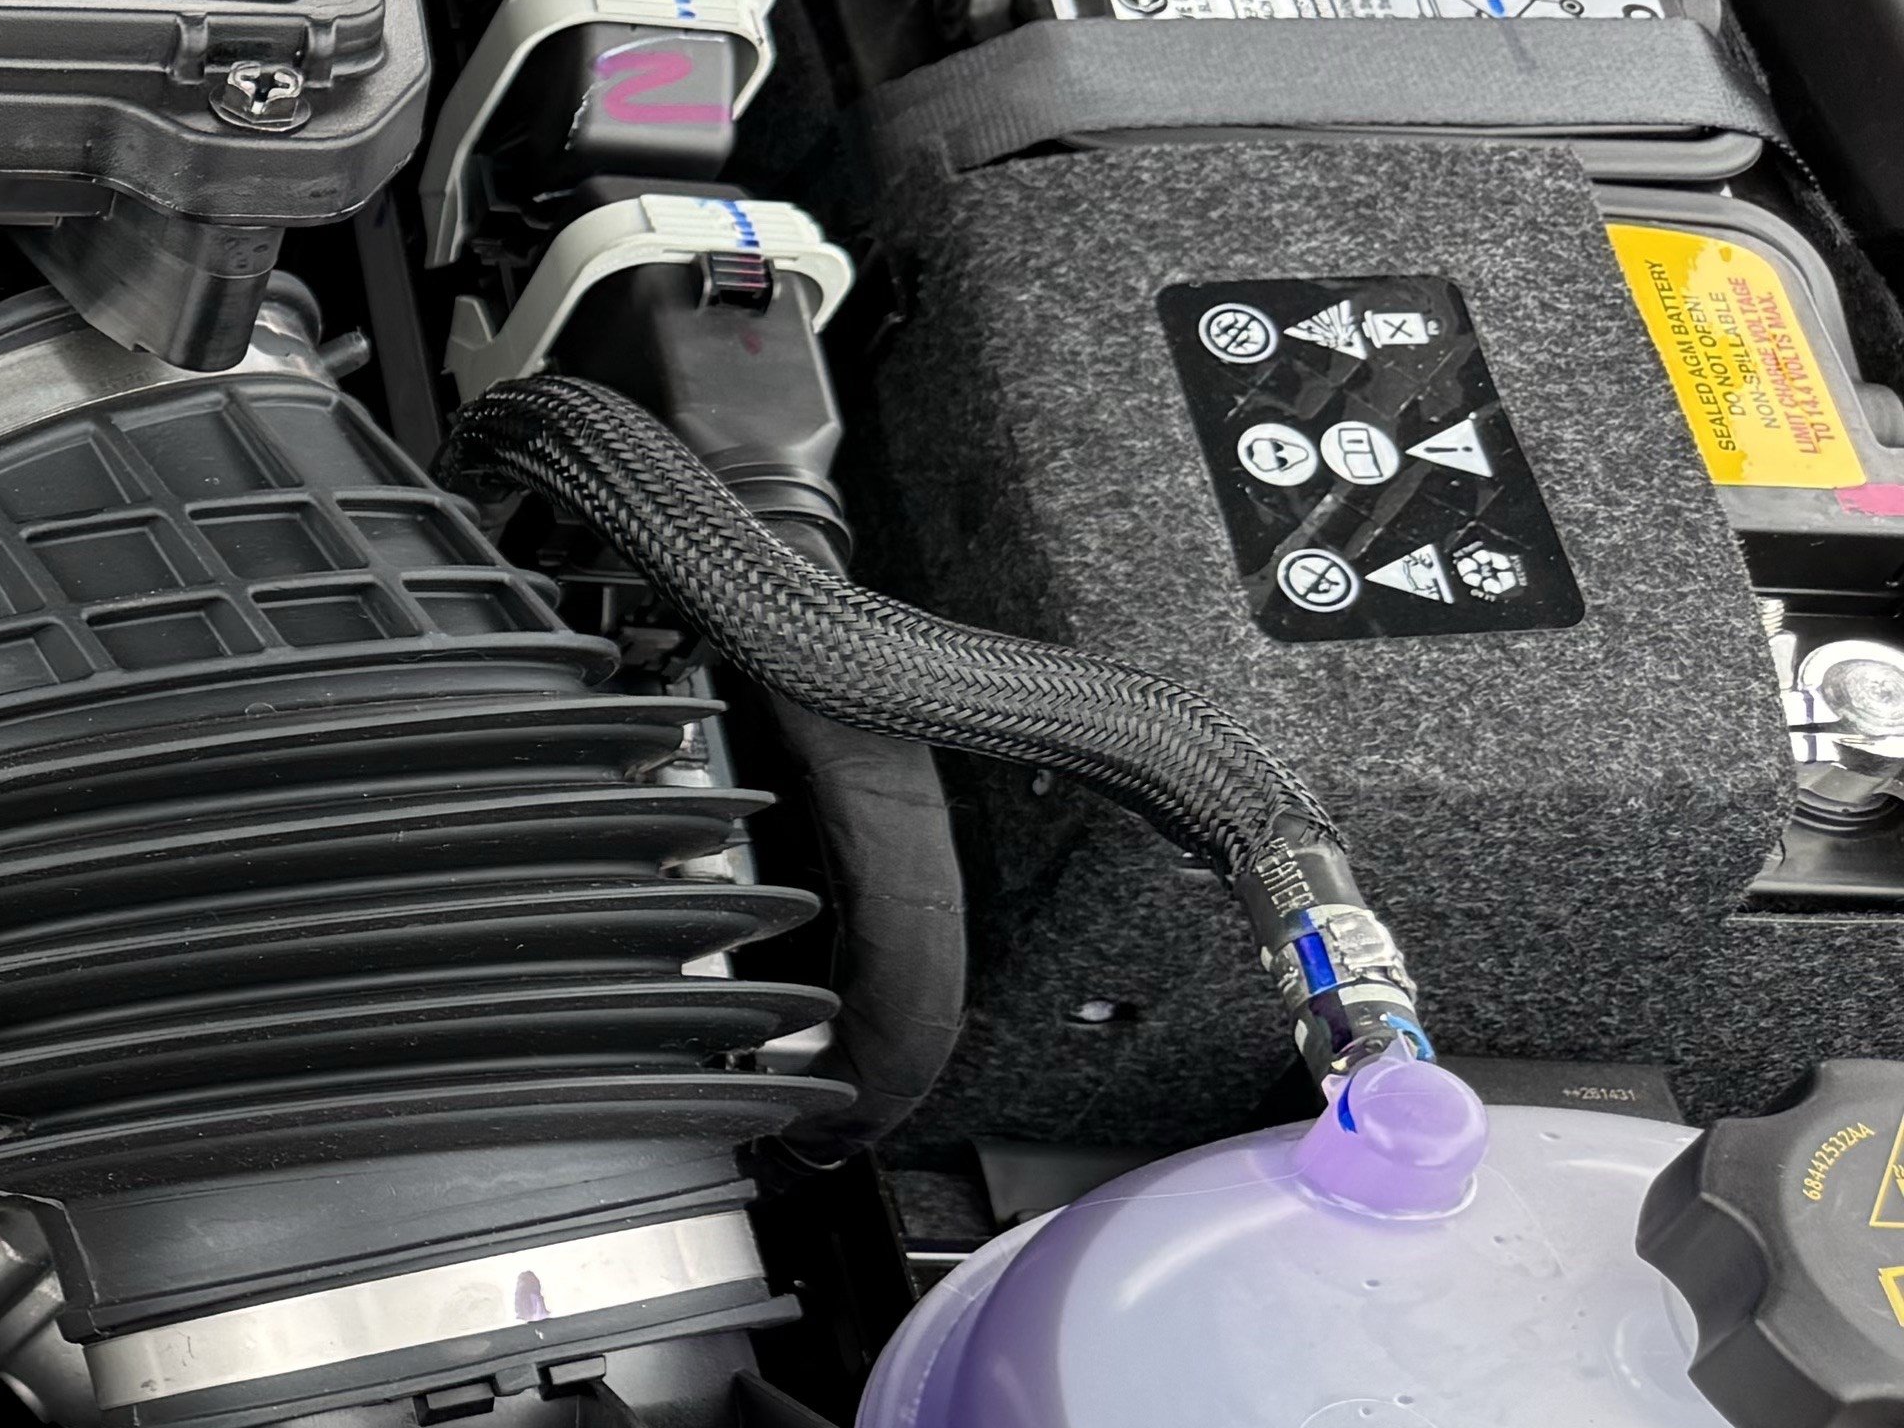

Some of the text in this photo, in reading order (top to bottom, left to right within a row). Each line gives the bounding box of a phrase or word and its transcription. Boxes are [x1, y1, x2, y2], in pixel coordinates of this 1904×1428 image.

[1648, 260, 1736, 450] SEALED AGM BATTERY
[1688, 296, 1746, 414] DO NOT OPEN!
[1718, 292, 1777, 427] NON-SPILLABLE
[1728, 277, 1819, 452] LIMIT CHARGE VOLTAGE
[1756, 292, 1834, 439] TO 14.4 VOLTS MAX.
[1801, 1121, 1874, 1202] 68442532AA
